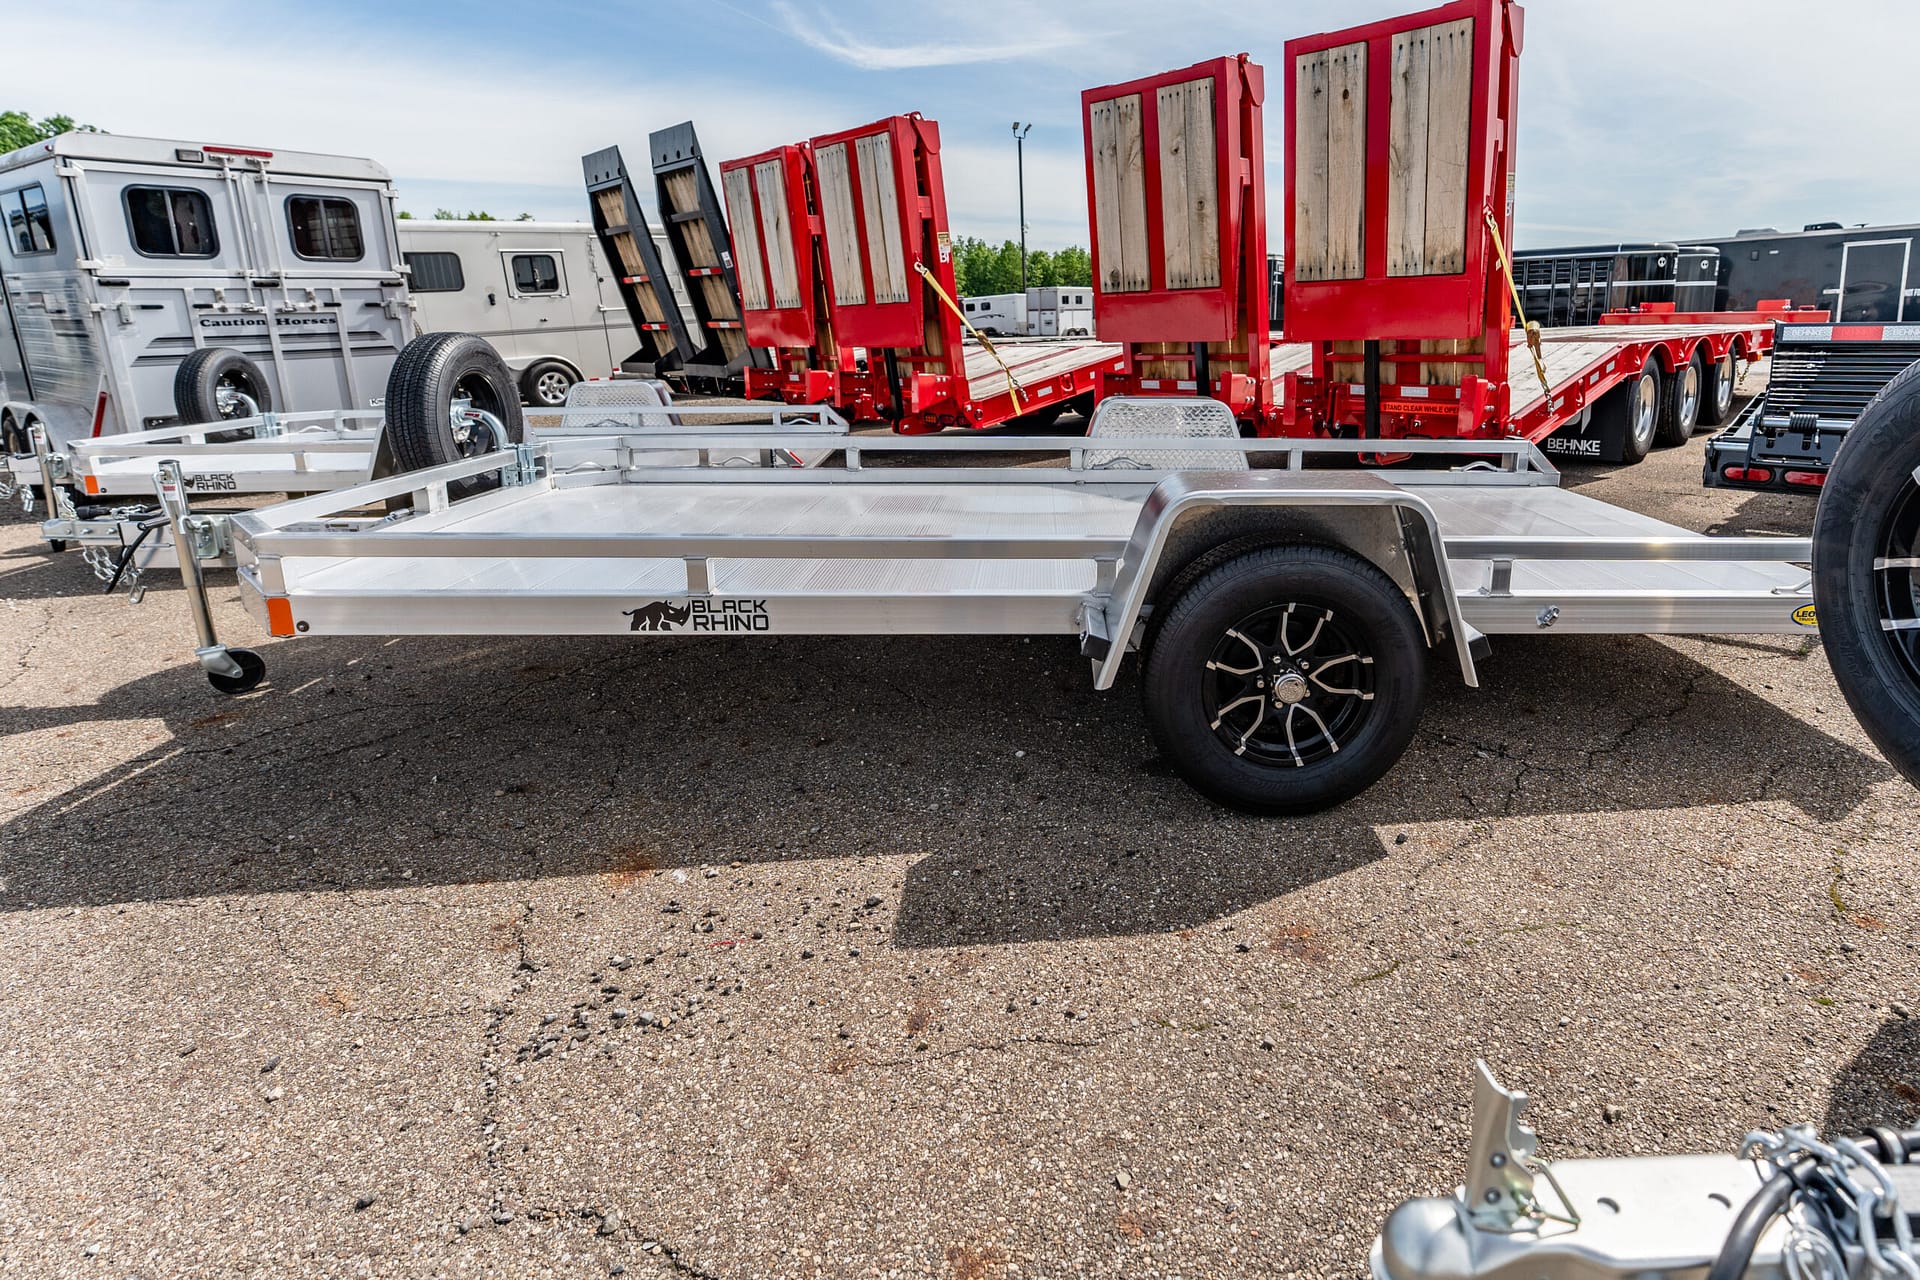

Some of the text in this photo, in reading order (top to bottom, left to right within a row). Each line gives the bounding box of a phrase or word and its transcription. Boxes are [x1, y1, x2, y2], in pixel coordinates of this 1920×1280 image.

[200, 317, 336, 327] Caution Horses
[1383, 403, 1402, 411] STAND
[1403, 404, 1422, 412] CLEAR
[1547, 438, 1600, 451] BEHNKE
[196, 481, 237, 490] RHINO
[692, 600, 768, 613] BLACK
[693, 614, 769, 631] RHINO
